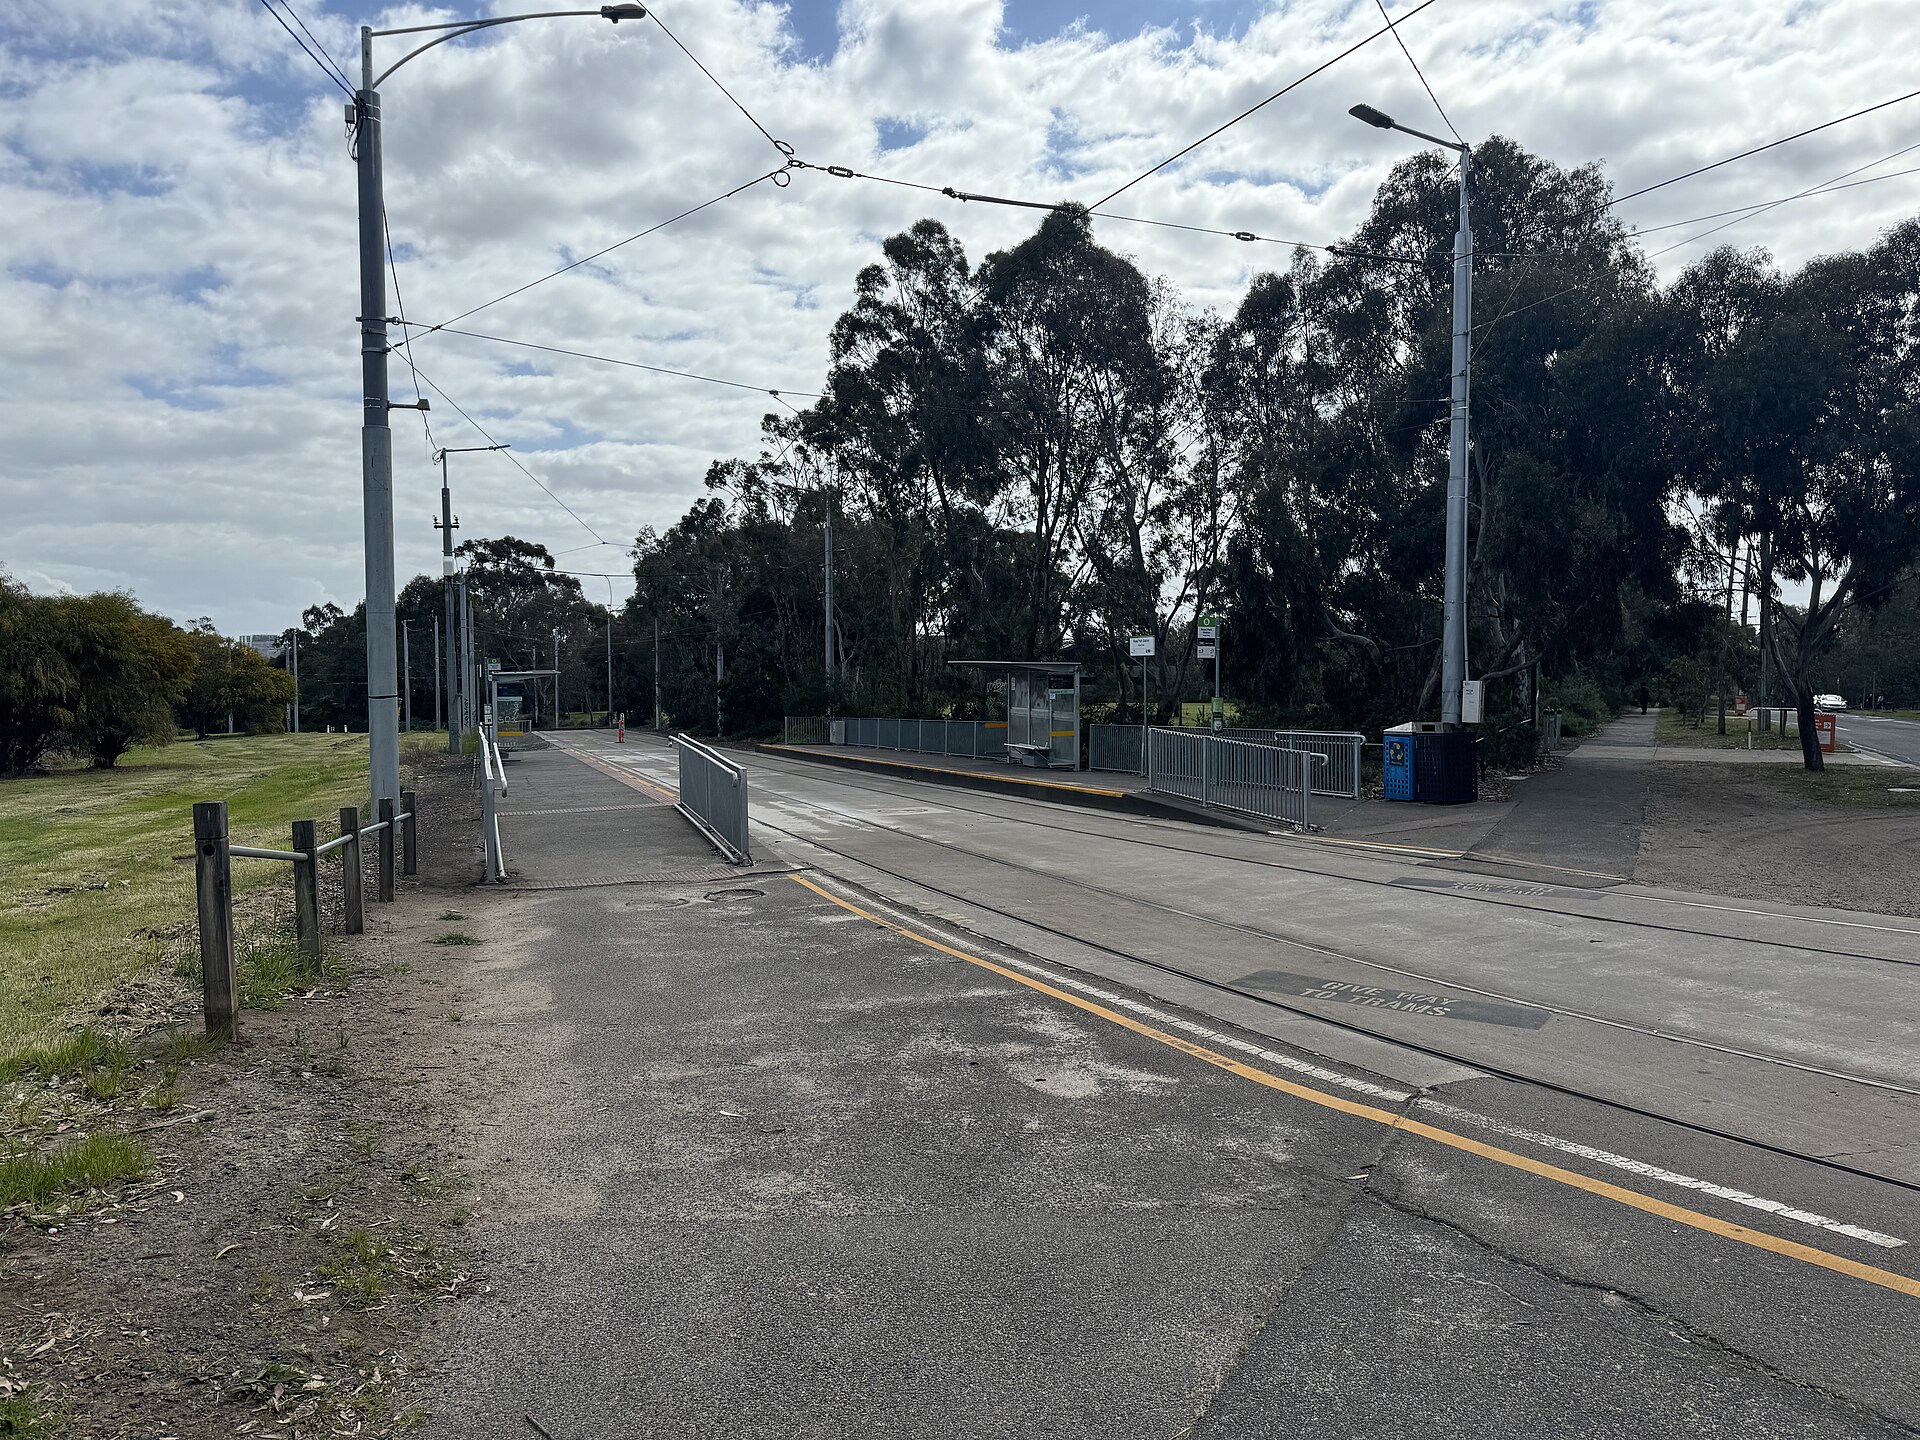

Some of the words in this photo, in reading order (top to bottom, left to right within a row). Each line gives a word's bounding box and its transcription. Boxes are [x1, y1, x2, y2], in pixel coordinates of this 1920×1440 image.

[1300, 988, 1338, 999] TO
[1348, 994, 1451, 1016] TRAMS
[1321, 981, 1385, 996] GIVE
[1396, 992, 1462, 1005] WAY
